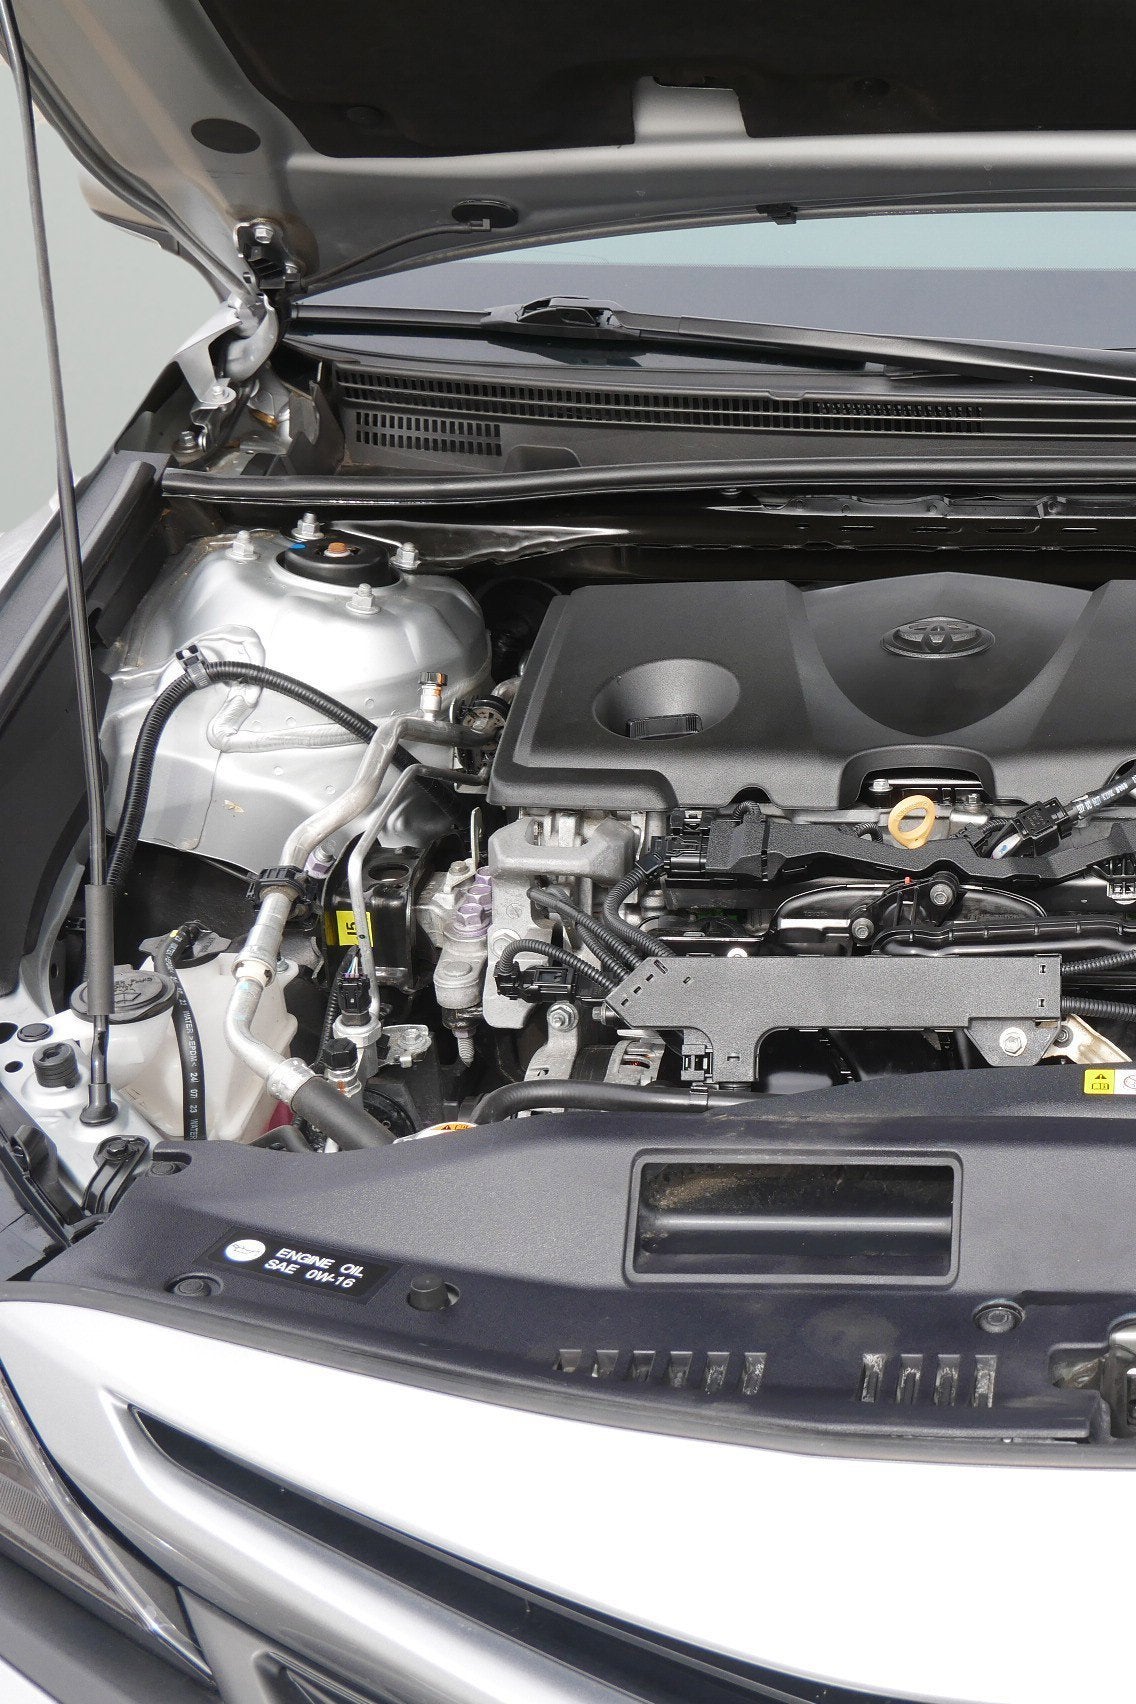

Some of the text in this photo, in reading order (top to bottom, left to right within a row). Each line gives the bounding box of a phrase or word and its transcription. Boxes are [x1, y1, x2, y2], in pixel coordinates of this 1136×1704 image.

[264, 1259, 356, 1288] SAE 0W-16
[275, 1248, 364, 1278] ENGINE OIL
